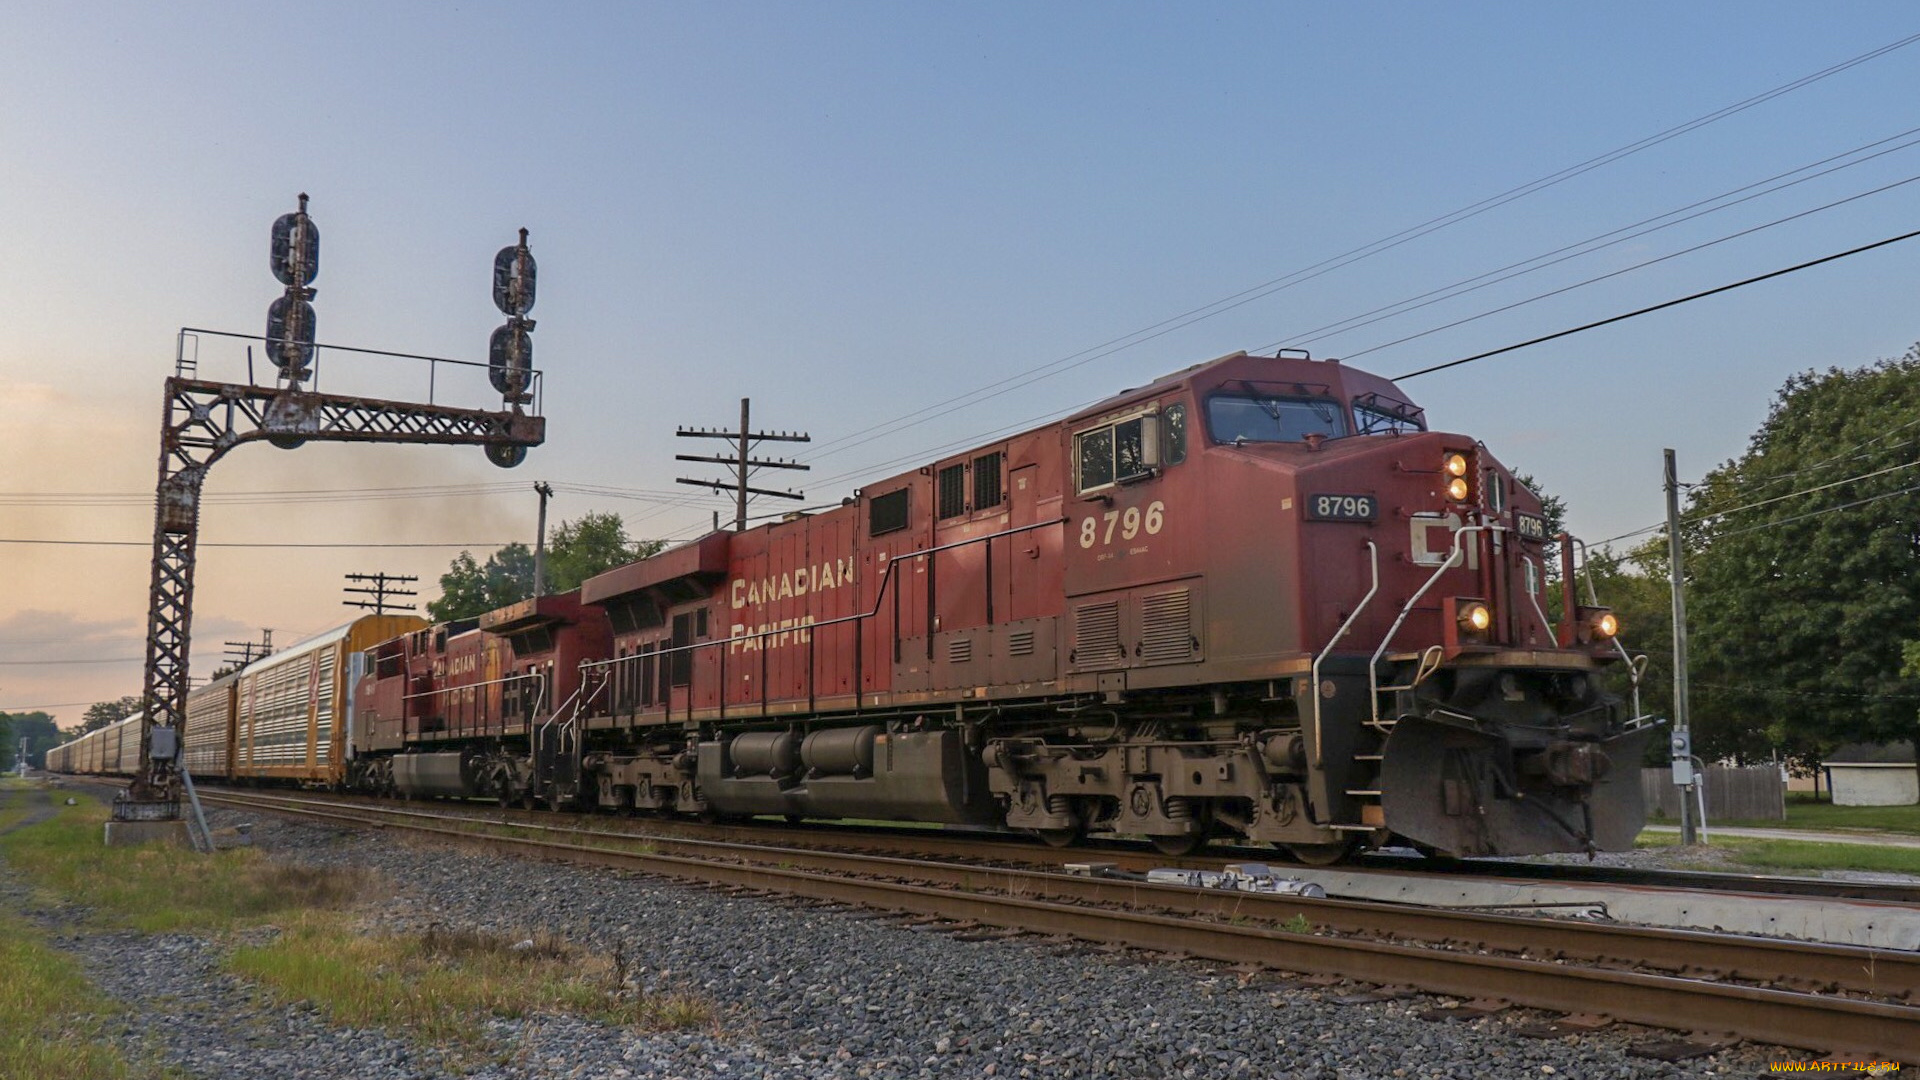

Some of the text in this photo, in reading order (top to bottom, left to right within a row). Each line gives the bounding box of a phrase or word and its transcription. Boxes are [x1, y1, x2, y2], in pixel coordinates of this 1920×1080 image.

[1080, 500, 1165, 549] 8796
[1318, 496, 1370, 517] 8796
[1519, 515, 1543, 537] 8796
[731, 555, 854, 610] CANADIAN
[730, 614, 815, 655] PACIFIC
